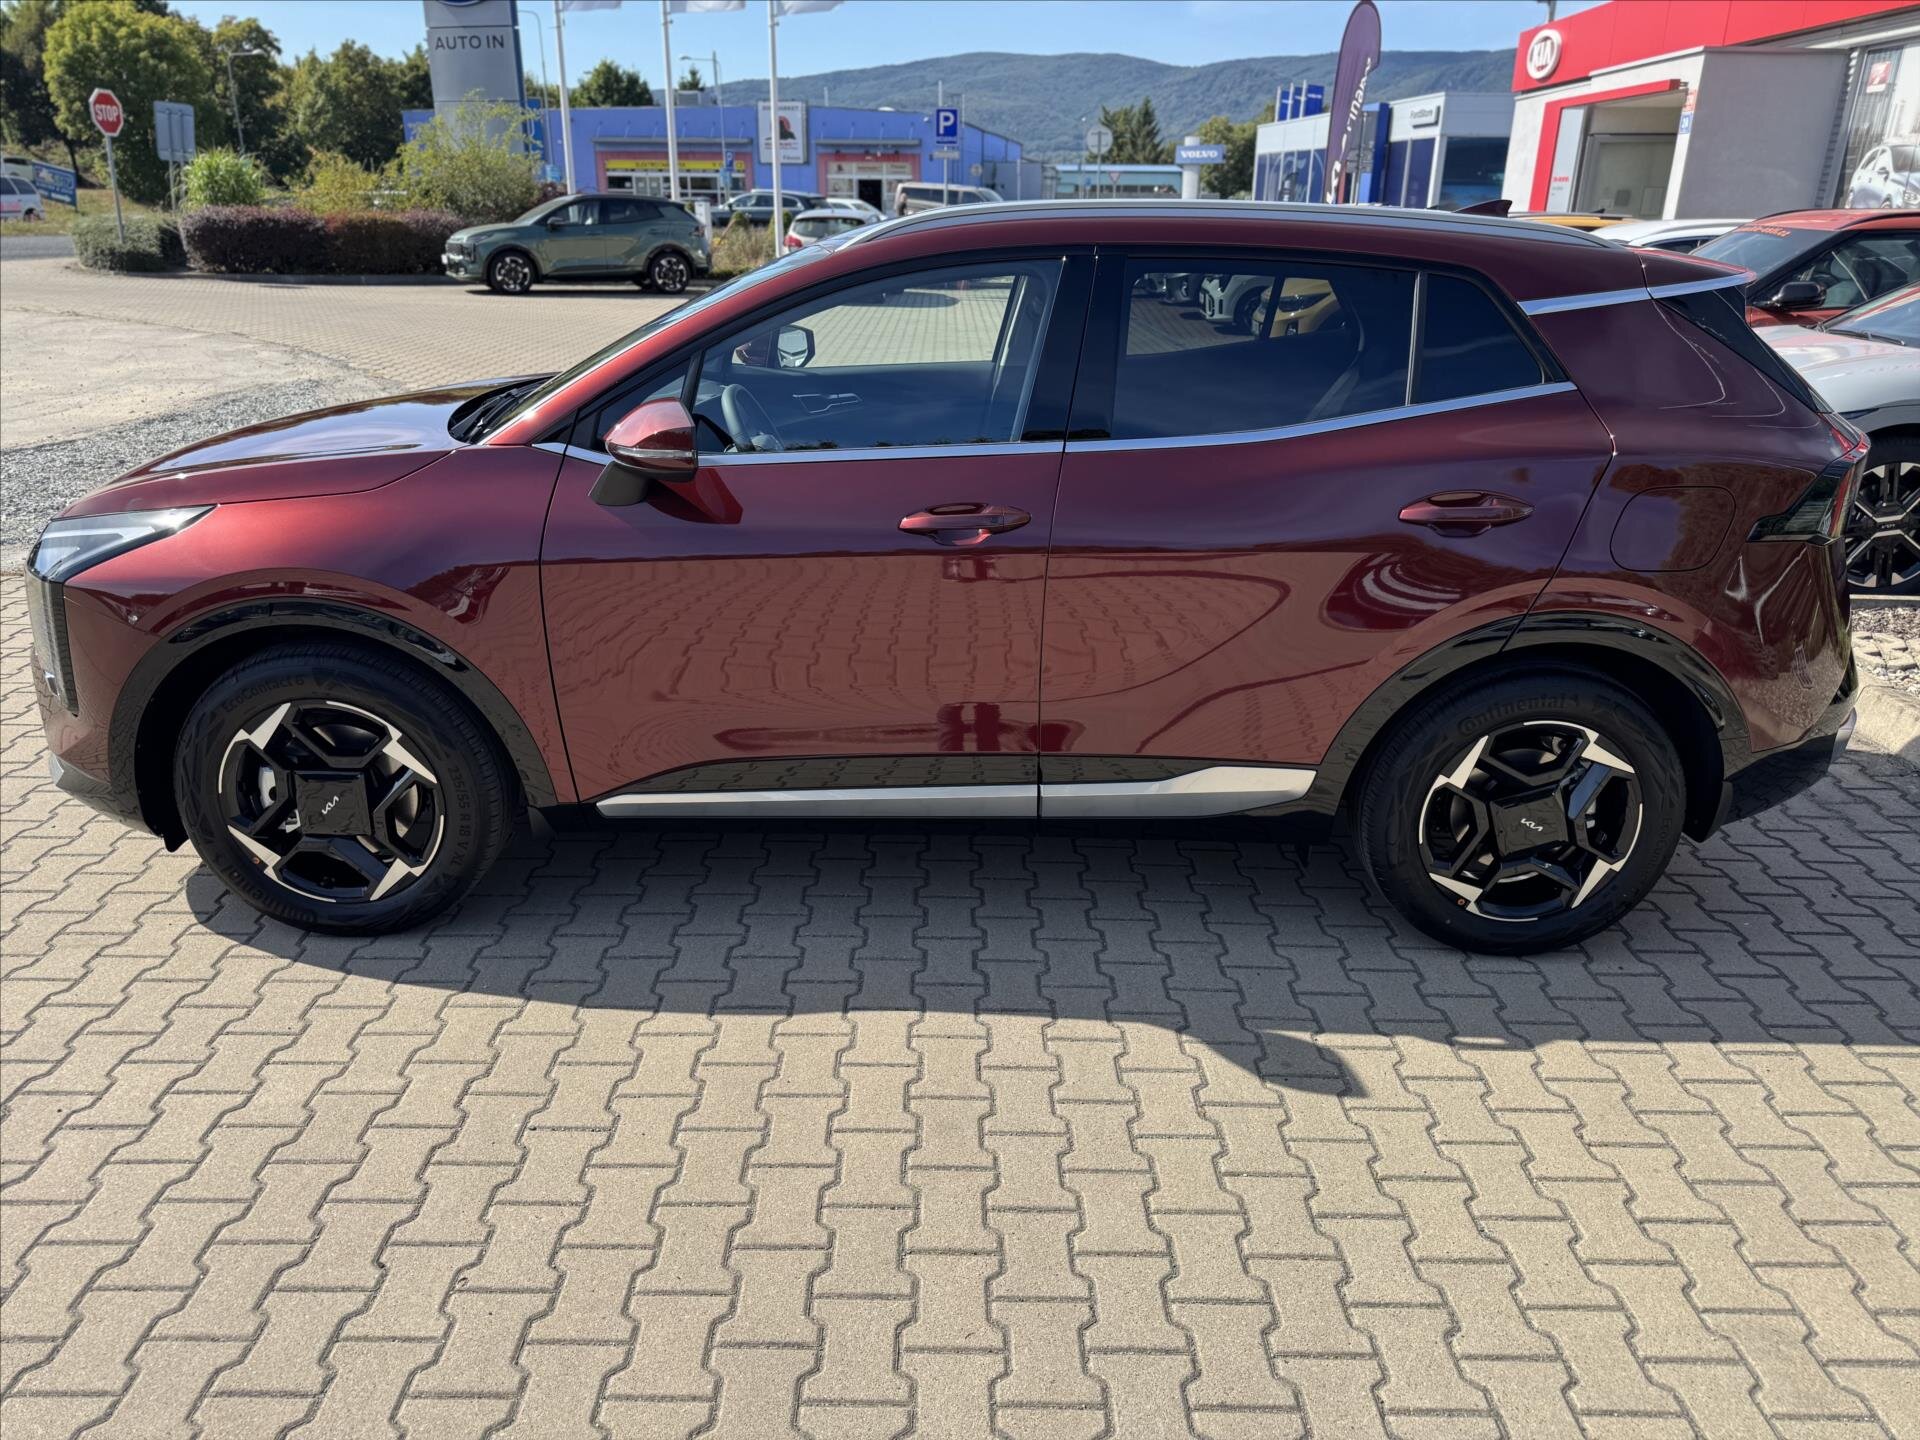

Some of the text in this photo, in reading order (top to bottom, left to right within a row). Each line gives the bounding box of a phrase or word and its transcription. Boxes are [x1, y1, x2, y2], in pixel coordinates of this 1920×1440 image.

[435, 34, 505, 50] AUTO IN
[95, 104, 119, 121] STOP
[939, 111, 955, 135] P
[1180, 150, 1218, 158] VOLVO
[221, 675, 294, 713] EcoContact
